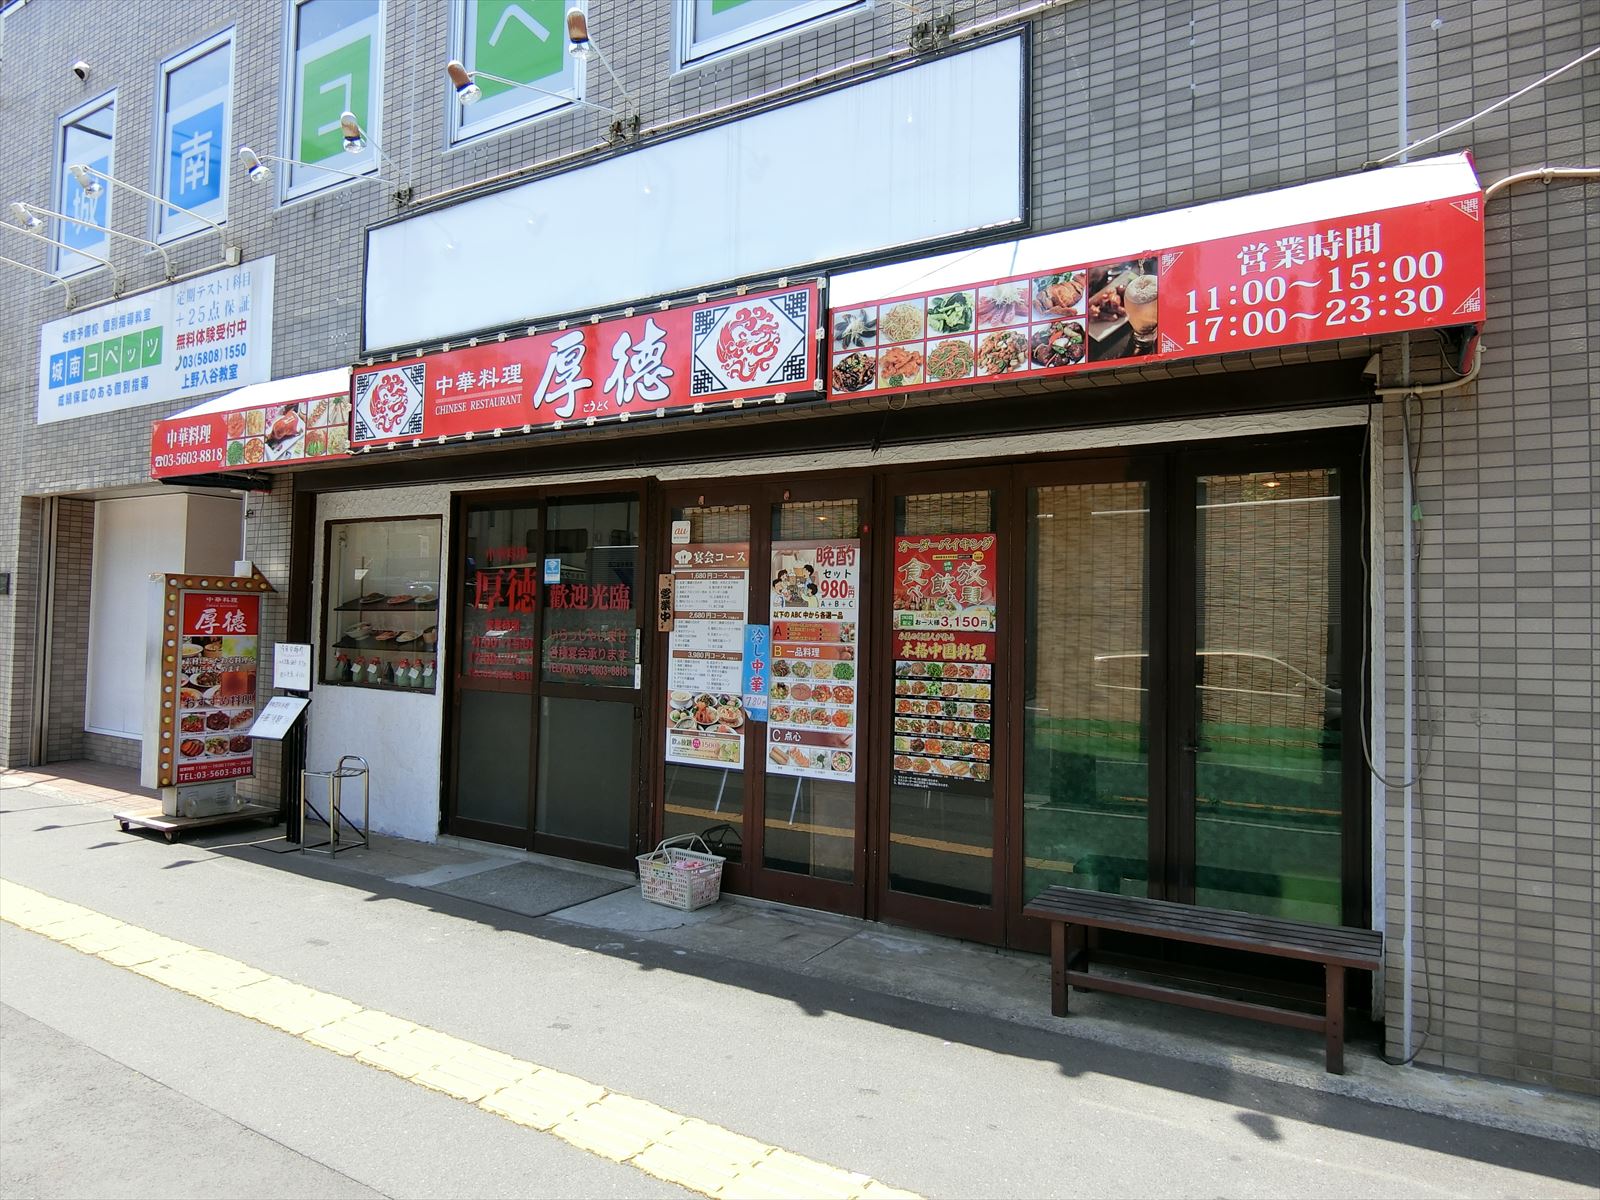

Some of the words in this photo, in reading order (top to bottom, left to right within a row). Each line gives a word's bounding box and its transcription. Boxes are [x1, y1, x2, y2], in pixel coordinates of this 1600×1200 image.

[318, 73, 353, 136] コ
[179, 130, 213, 195] 南
[72, 177, 99, 235] 城
[1236, 222, 1383, 277] 営業時間
[62, 321, 99, 344] 城南予備校
[103, 307, 152, 333] 個別指導教室
[176, 319, 248, 351] 無料体験受付中
[51, 336, 160, 383] 城南コペッツ
[182, 342, 247, 371] 03(5808)1550
[181, 364, 239, 390] 上野入谷教室
[435, 362, 524, 397] 中華料理
[57, 376, 150, 407] 成績保証のある個別指導
[435, 397, 467, 416] CHINESE
[470, 393, 523, 412] RESTAURANT
[583, 400, 609, 414] こうとく
[166, 424, 212, 449] 中華料理
[816, 545, 856, 567] 晩酌
[898, 535, 995, 553] オーダーバイキング
[693, 551, 746, 564] 宴会コース
[823, 569, 852, 579] セット
[774, 624, 782, 637] A
[940, 616, 988, 628] 3,150円
[751, 627, 765, 692] 冷し中華
[774, 646, 782, 657] B
[786, 647, 820, 658] 一品料理
[901, 641, 987, 661] 本格中国料理
[772, 729, 781, 742] C
[784, 731, 802, 742] 点心
[179, 766, 251, 781] TEL:03-5603-8818
